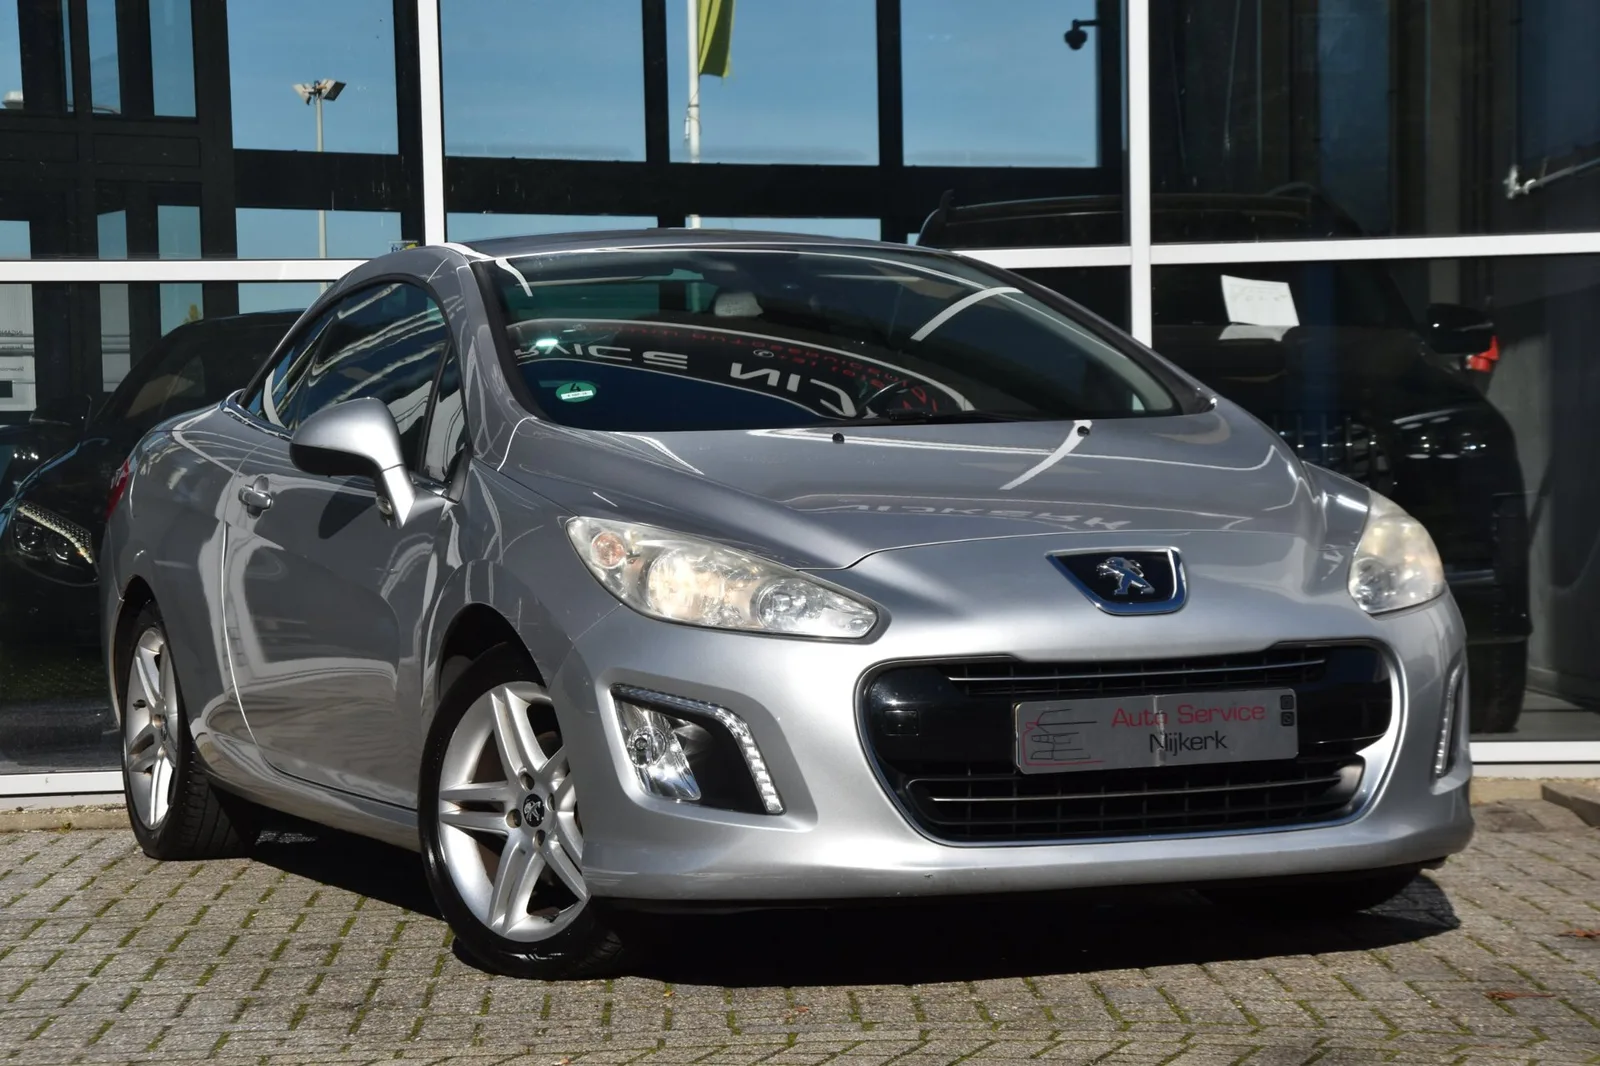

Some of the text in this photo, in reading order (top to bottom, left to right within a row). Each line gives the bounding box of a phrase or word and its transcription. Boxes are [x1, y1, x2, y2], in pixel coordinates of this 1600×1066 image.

[1111, 704, 1266, 728] Auto Service
[1149, 731, 1228, 756] Nijkerk
